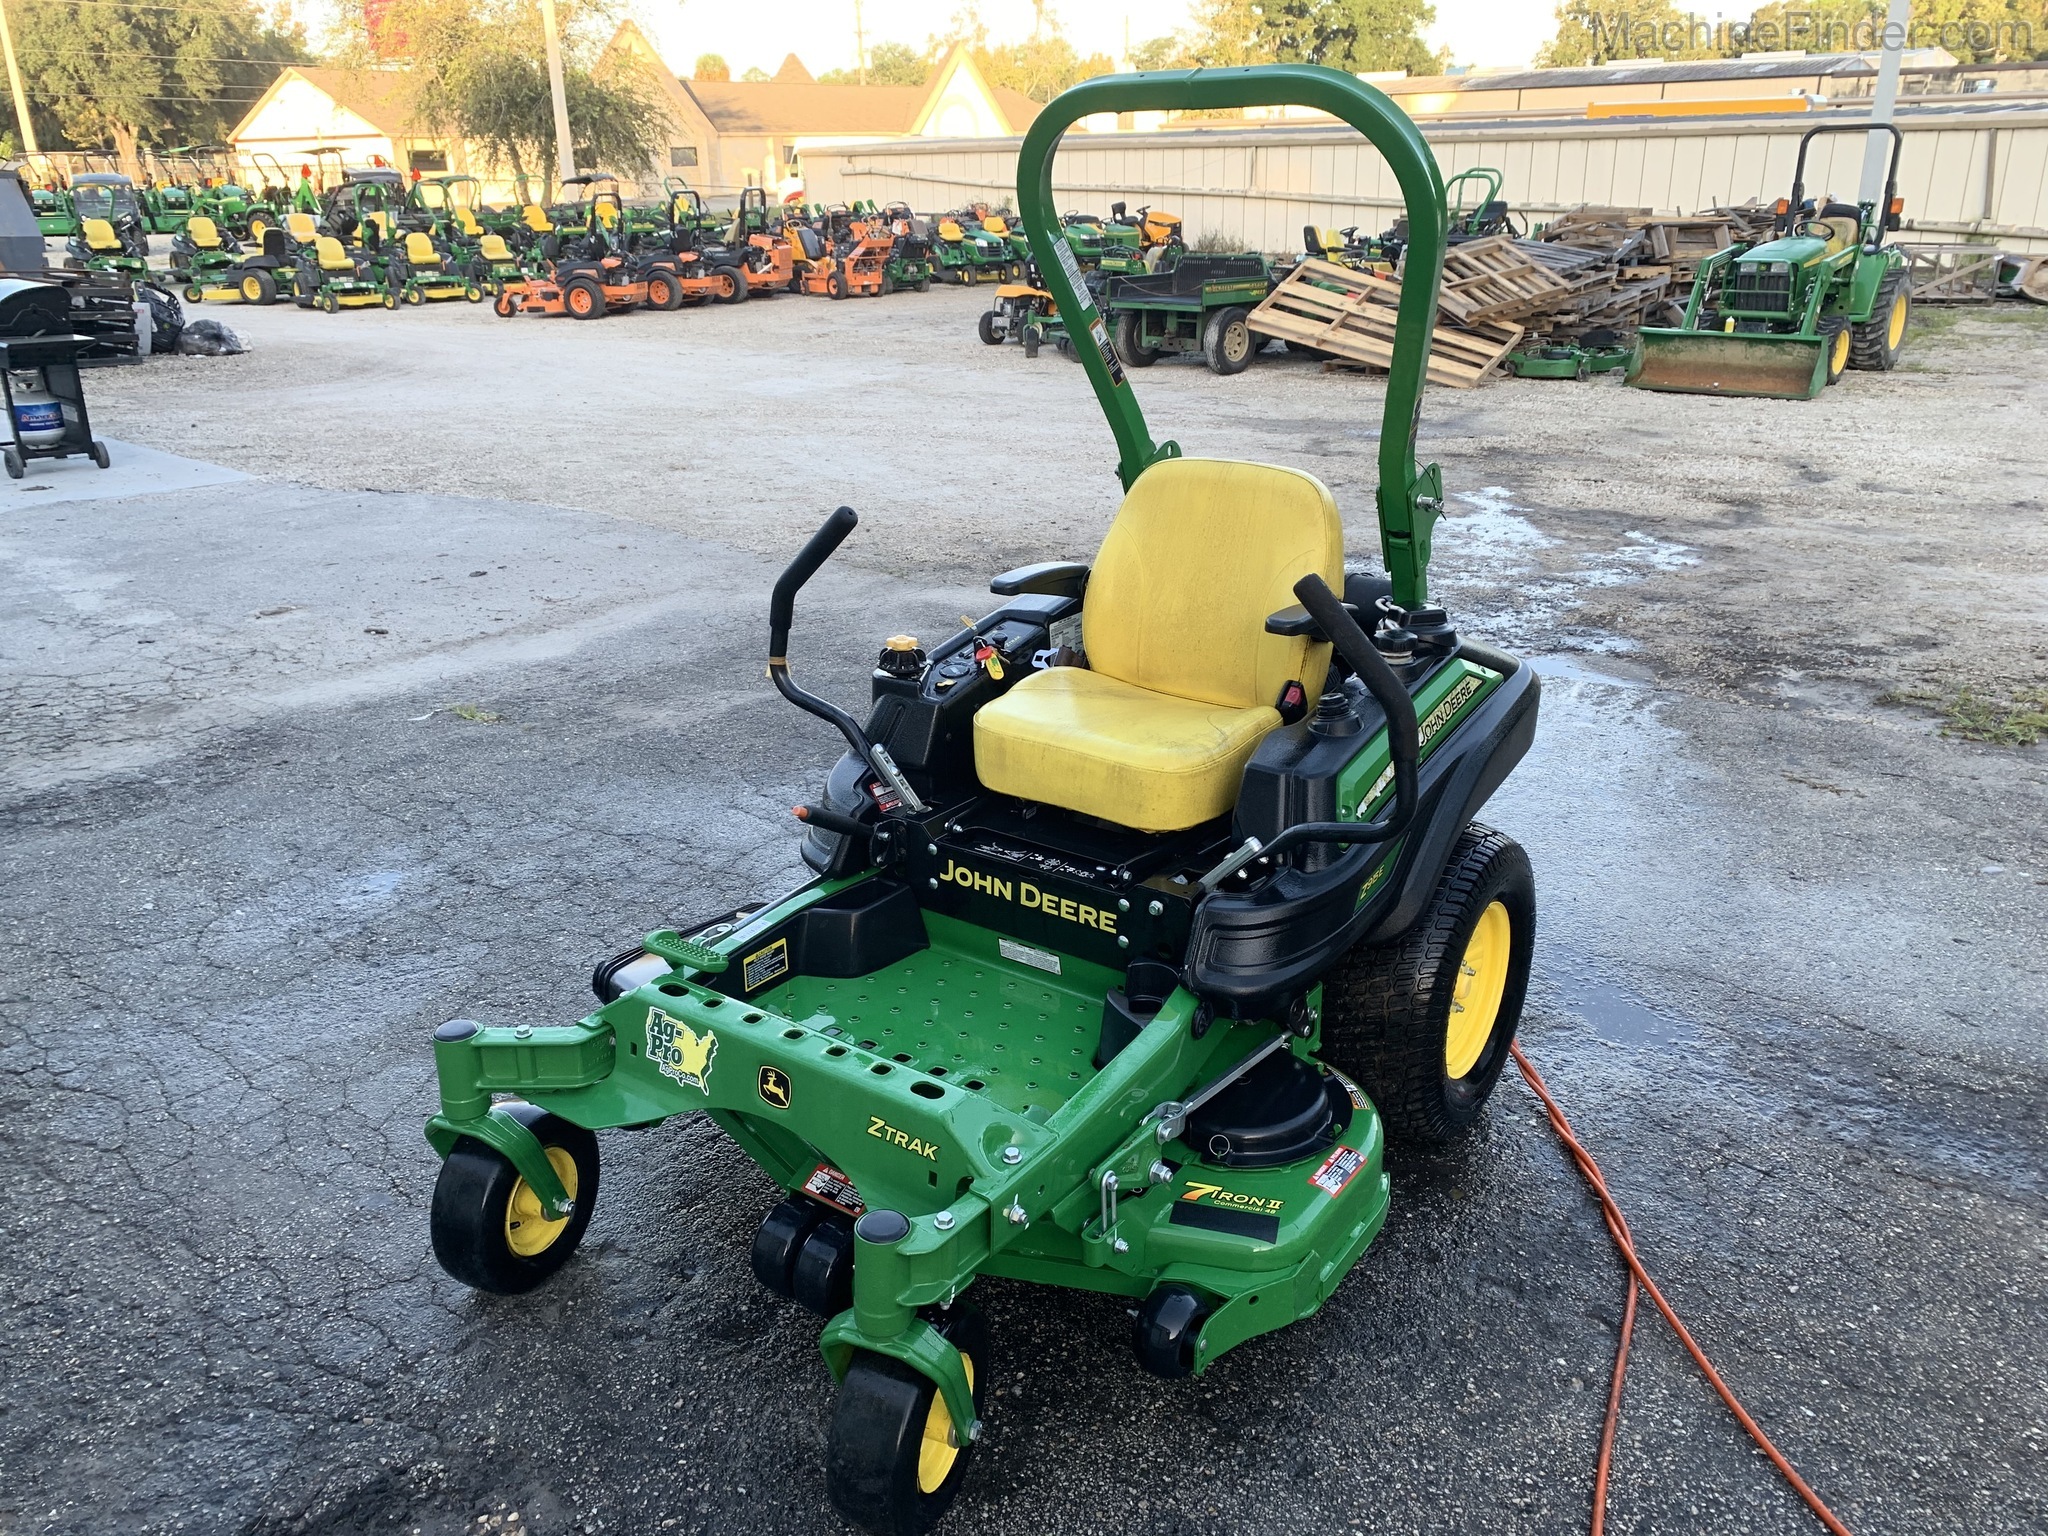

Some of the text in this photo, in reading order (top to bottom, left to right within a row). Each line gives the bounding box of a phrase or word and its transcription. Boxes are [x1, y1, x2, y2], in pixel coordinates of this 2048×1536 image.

[1420, 680, 1473, 747] JOHN DEERE
[939, 858, 1118, 935] JOHN DEERE
[649, 1011, 683, 1043] Ag-
[649, 1034, 683, 1066] Pro
[866, 1115, 939, 1162] ZTRAK
[1213, 1199, 1263, 1213] Commercial
